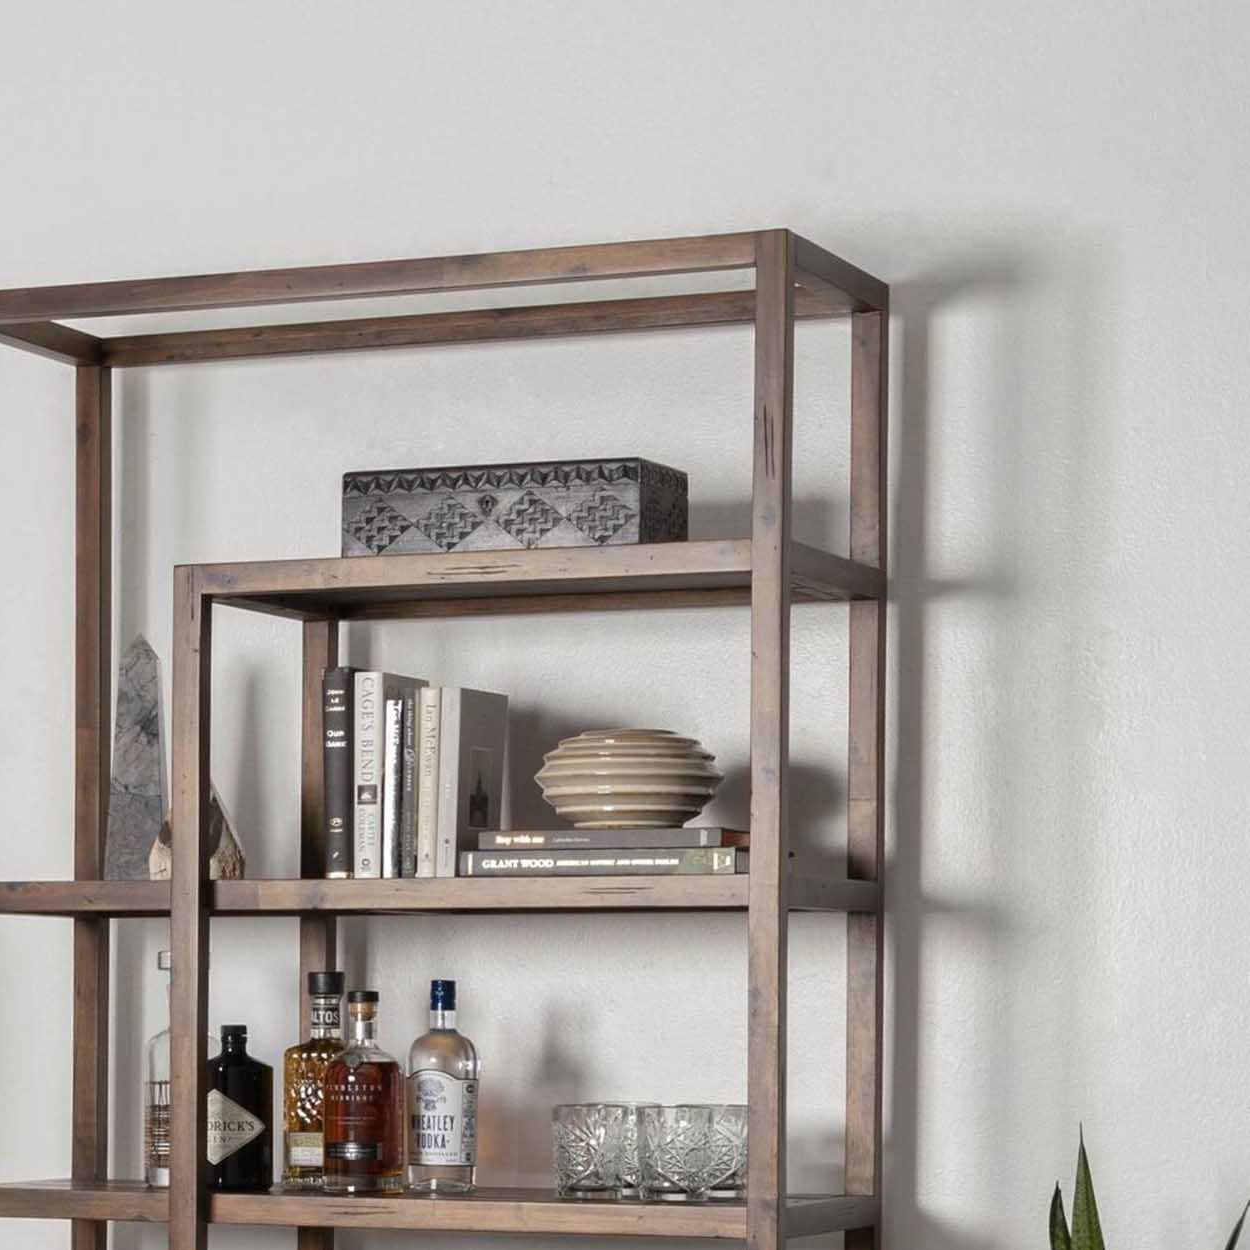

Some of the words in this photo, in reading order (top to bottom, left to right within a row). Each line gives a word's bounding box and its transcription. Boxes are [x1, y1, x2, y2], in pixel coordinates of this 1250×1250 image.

[361, 677, 375, 731] CAGE'S
[425, 704, 437, 722] Ian
[361, 739, 375, 783] BEND
[424, 727, 437, 777] McEwan
[481, 859, 519, 869] GRANT
[520, 859, 554, 869] WOOD
[208, 1121, 255, 1132] DRICK'S
[415, 1133, 447, 1150] VODKA
